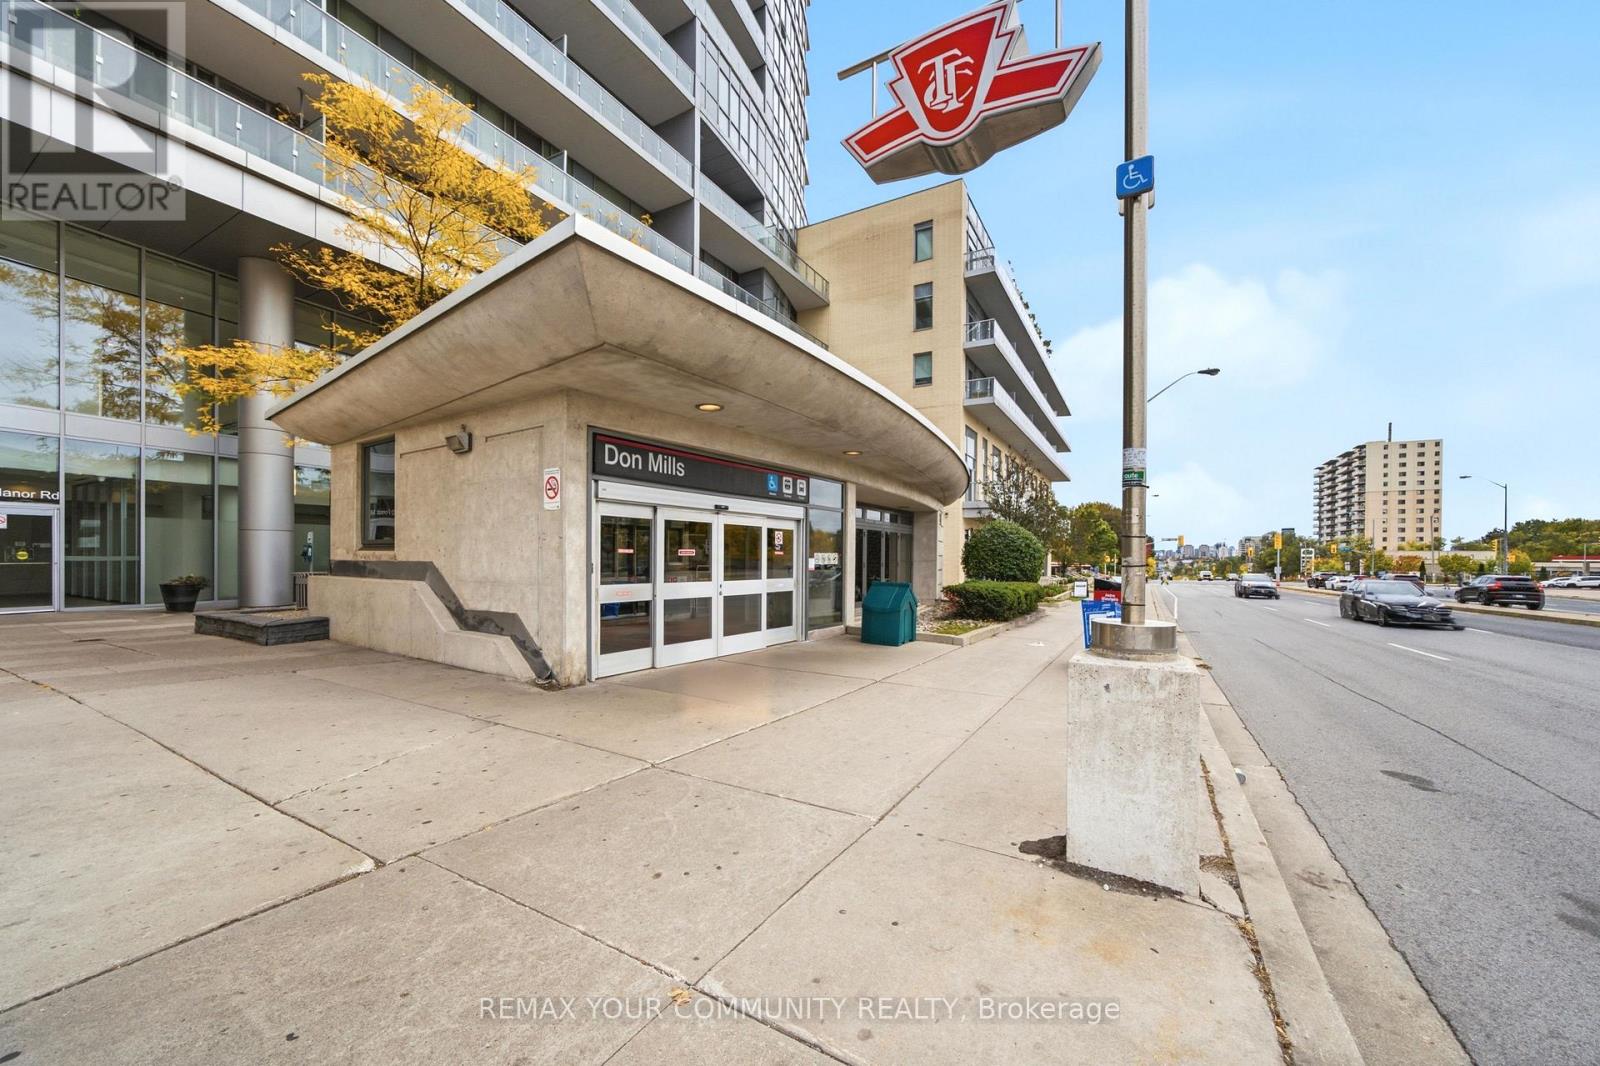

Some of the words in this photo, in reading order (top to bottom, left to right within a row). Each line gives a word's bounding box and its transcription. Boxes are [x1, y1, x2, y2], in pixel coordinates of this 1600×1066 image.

[604, 443, 642, 470] Don
[648, 452, 685, 477] Mills
[0, 488, 36, 498] anor
[40, 490, 60, 500] Rd
